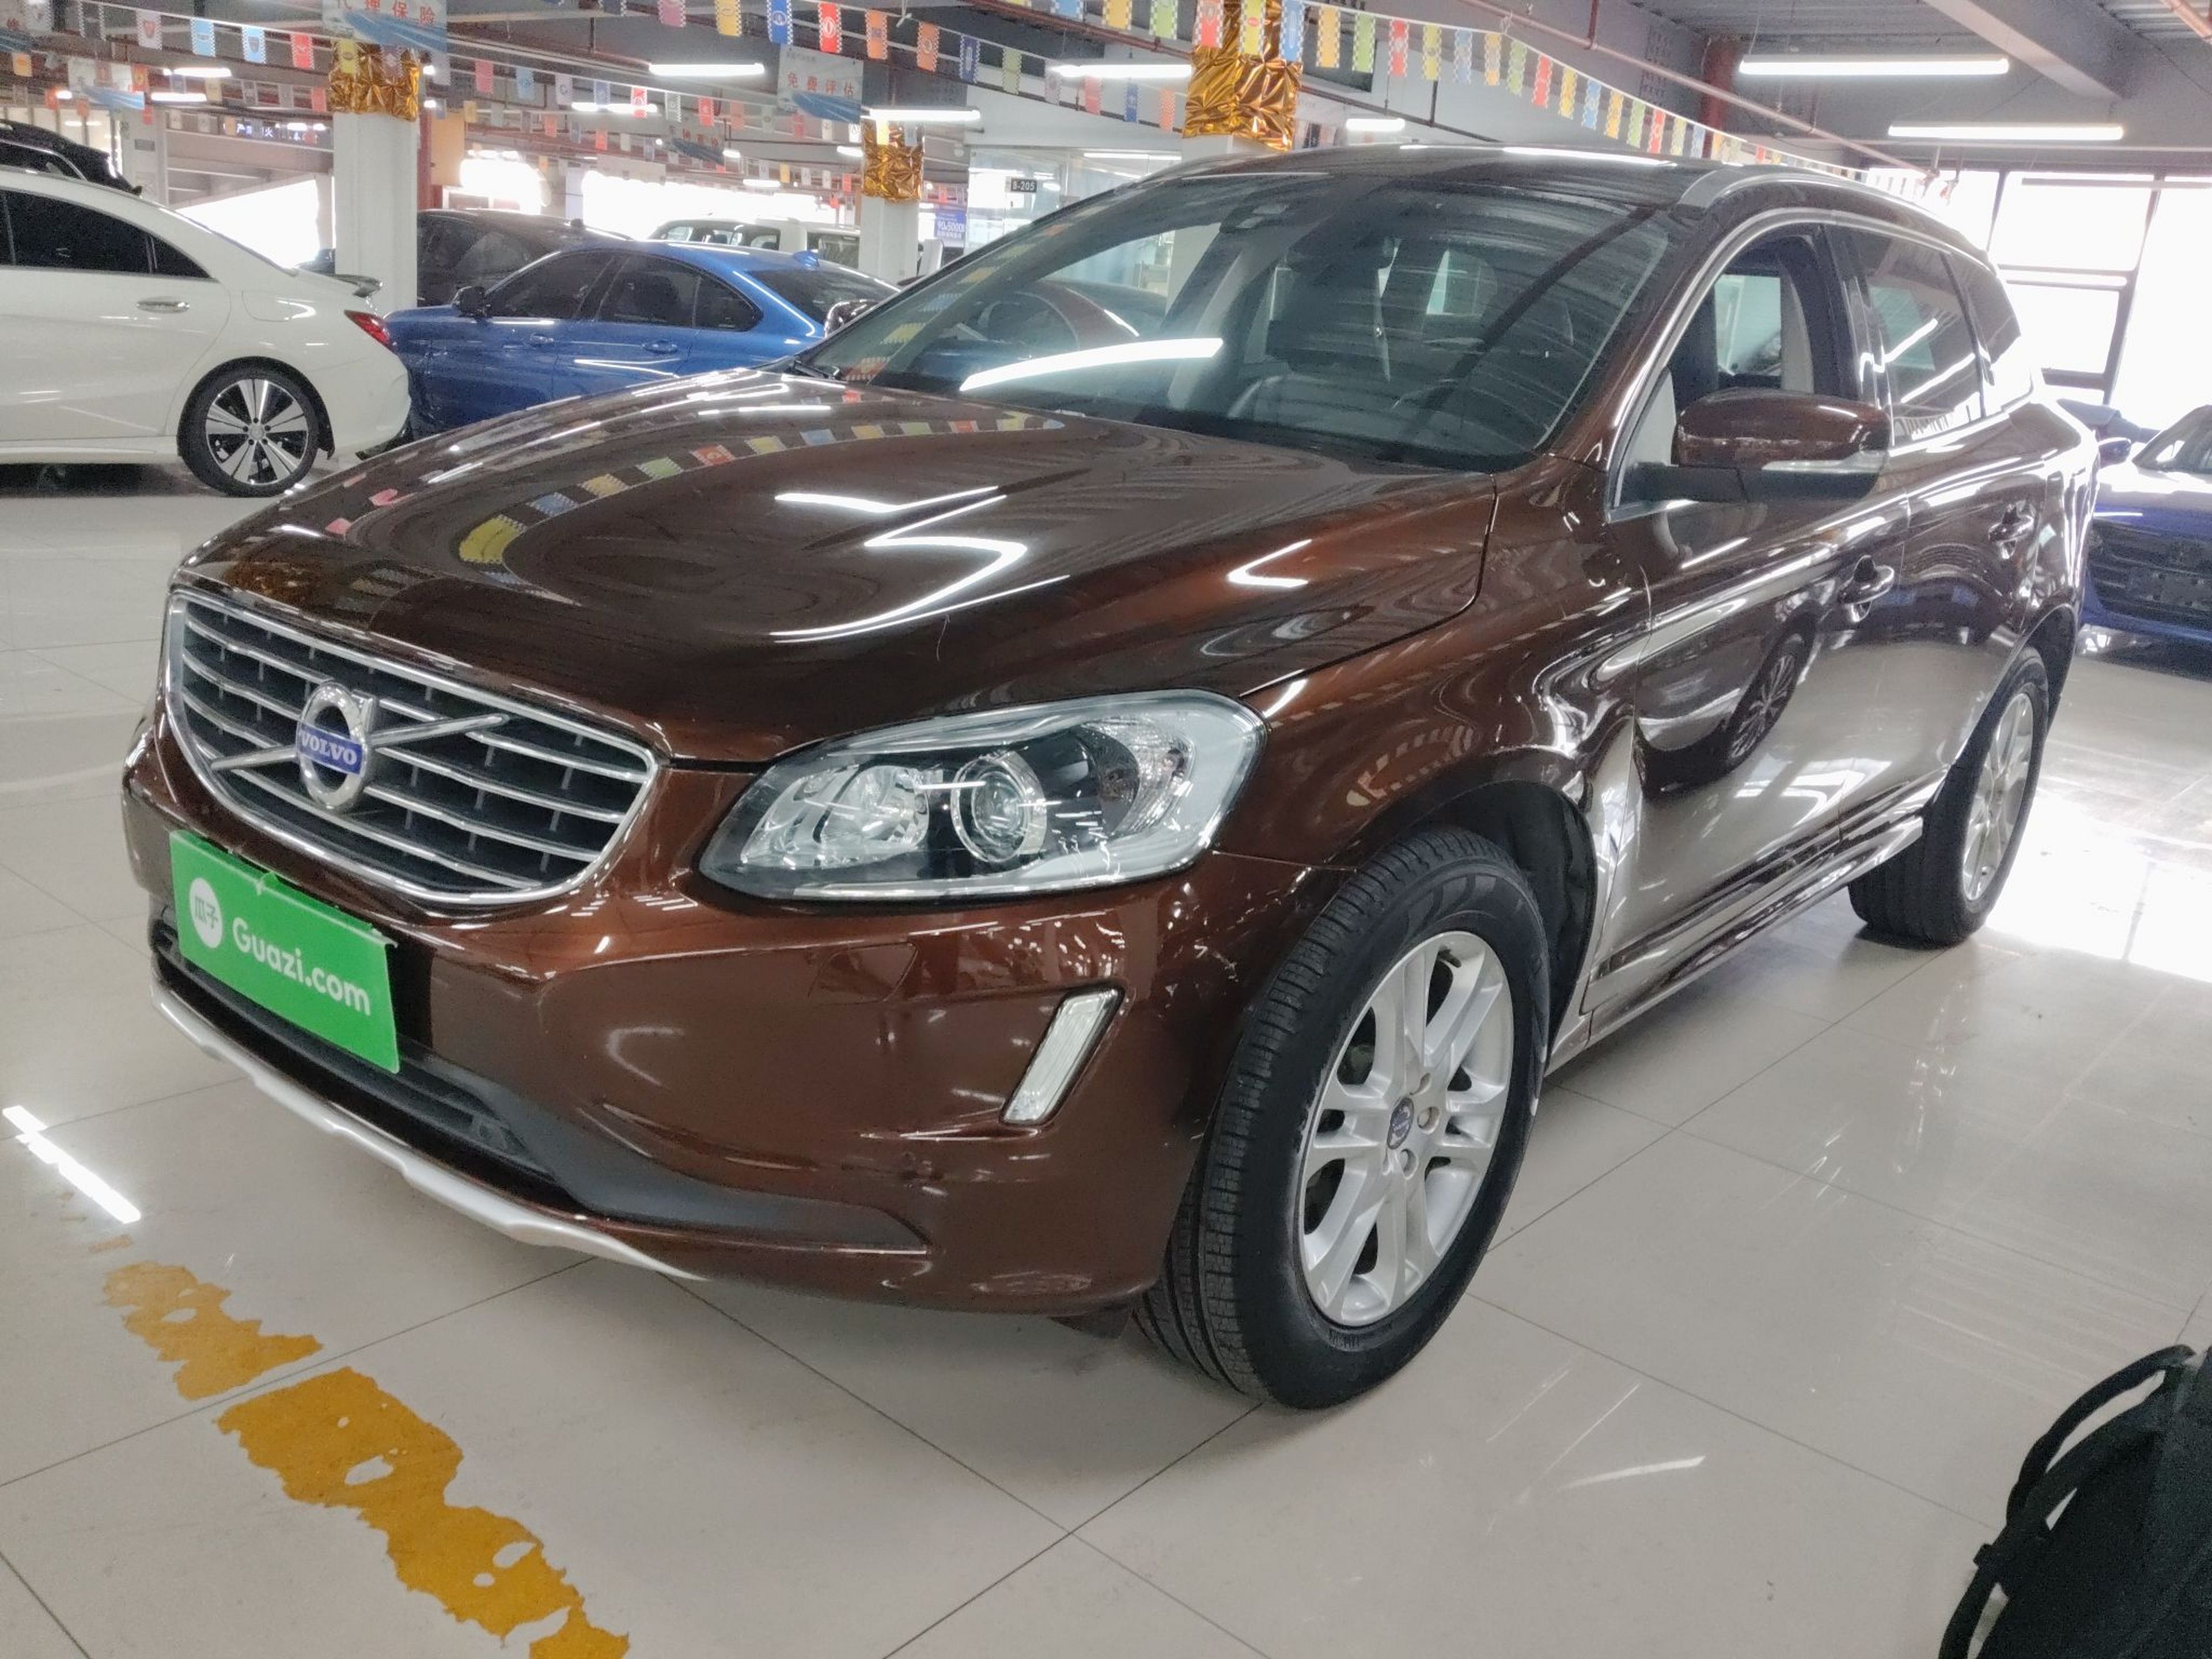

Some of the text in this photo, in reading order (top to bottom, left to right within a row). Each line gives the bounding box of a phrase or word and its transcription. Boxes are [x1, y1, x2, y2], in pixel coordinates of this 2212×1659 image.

[787, 72, 854, 96] 免费评估
[300, 729, 357, 765] VOLVO
[195, 895, 219, 930] 瓜子
[232, 916, 371, 1016] Guazi.com
